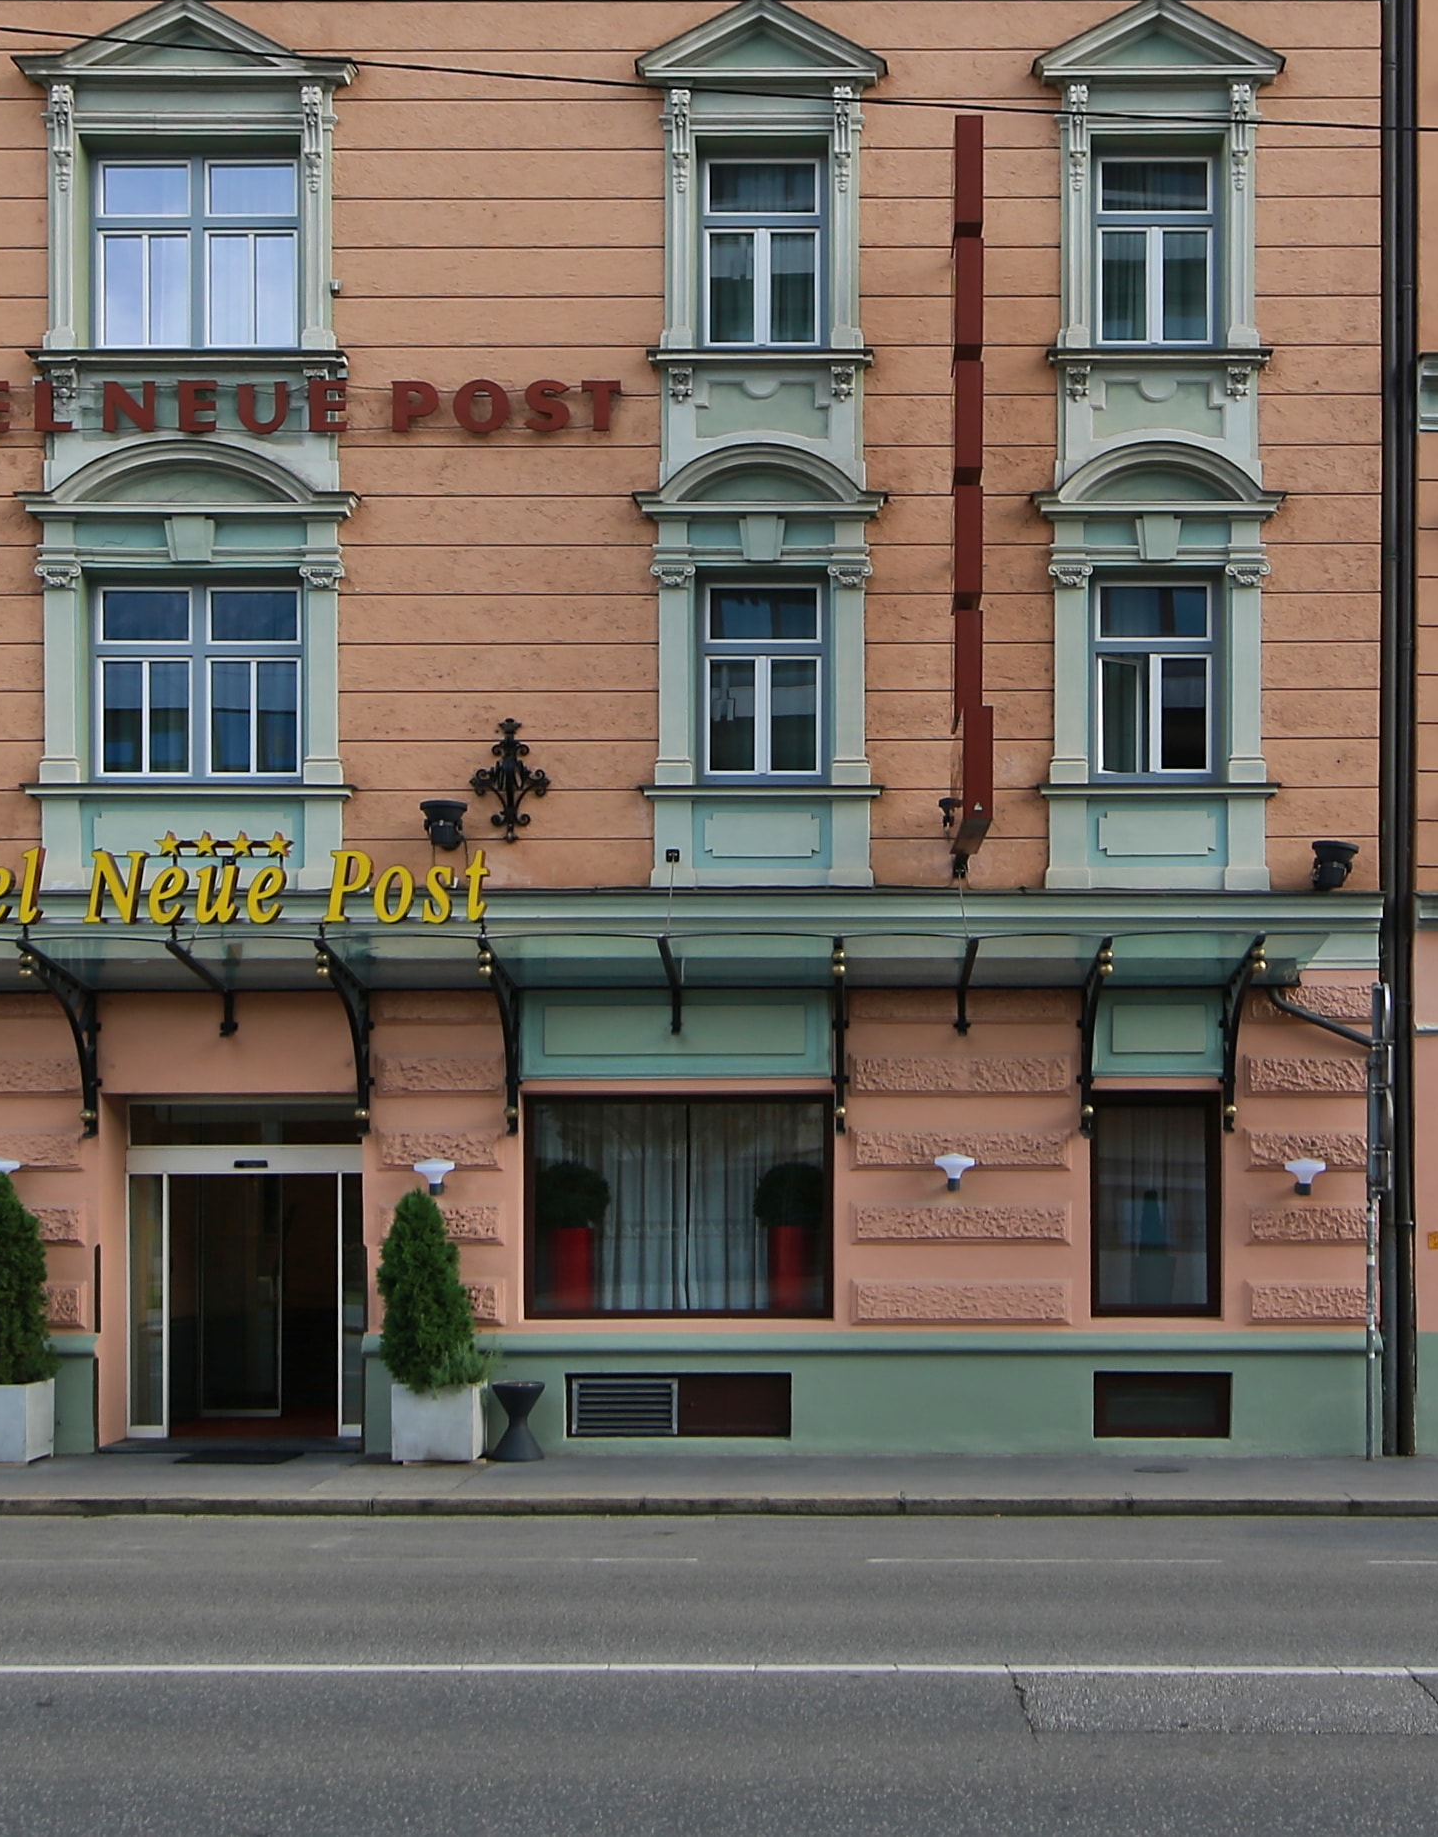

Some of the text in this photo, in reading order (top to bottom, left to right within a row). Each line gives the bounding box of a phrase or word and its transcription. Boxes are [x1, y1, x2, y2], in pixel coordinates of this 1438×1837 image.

[103, 378, 351, 435] NEUE
[390, 379, 623, 435] POST
[84, 849, 286, 925] Neue
[324, 849, 490, 925] Post
